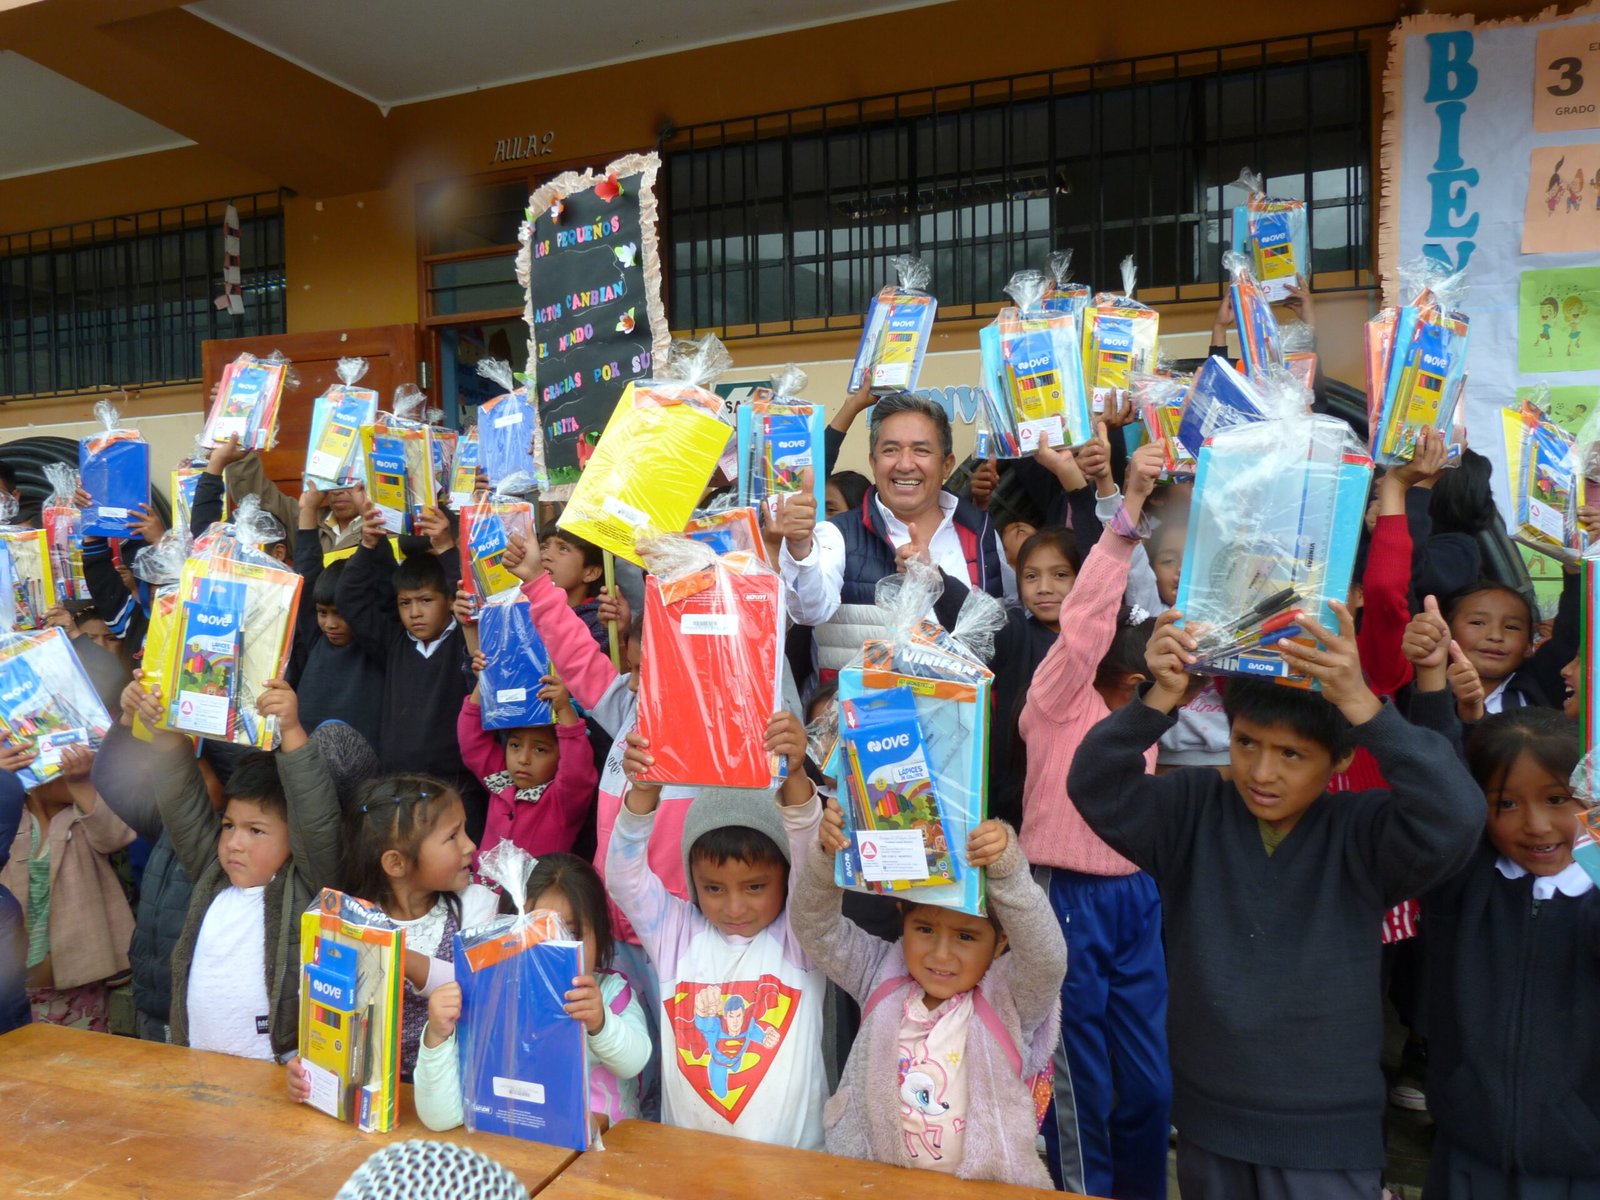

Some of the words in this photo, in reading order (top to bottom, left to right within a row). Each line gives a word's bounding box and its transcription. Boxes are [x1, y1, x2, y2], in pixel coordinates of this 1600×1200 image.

[1546, 56, 1584, 97] 3
[1555, 104, 1596, 116] GRADO
[491, 136, 538, 162] AULA
[541, 131, 556, 156] 2
[534, 239, 551, 259] LOS
[534, 303, 563, 324] ACTOS
[565, 281, 624, 310] CANBIAN
[538, 342, 550, 359] EL
[558, 323, 594, 352] MUNDO
[543, 371, 582, 403] GRACIAS
[593, 361, 621, 384] POR
[631, 352, 652, 374] SU
[547, 416, 580, 441] VISITA
[902, 649, 978, 676] VINIFAN
